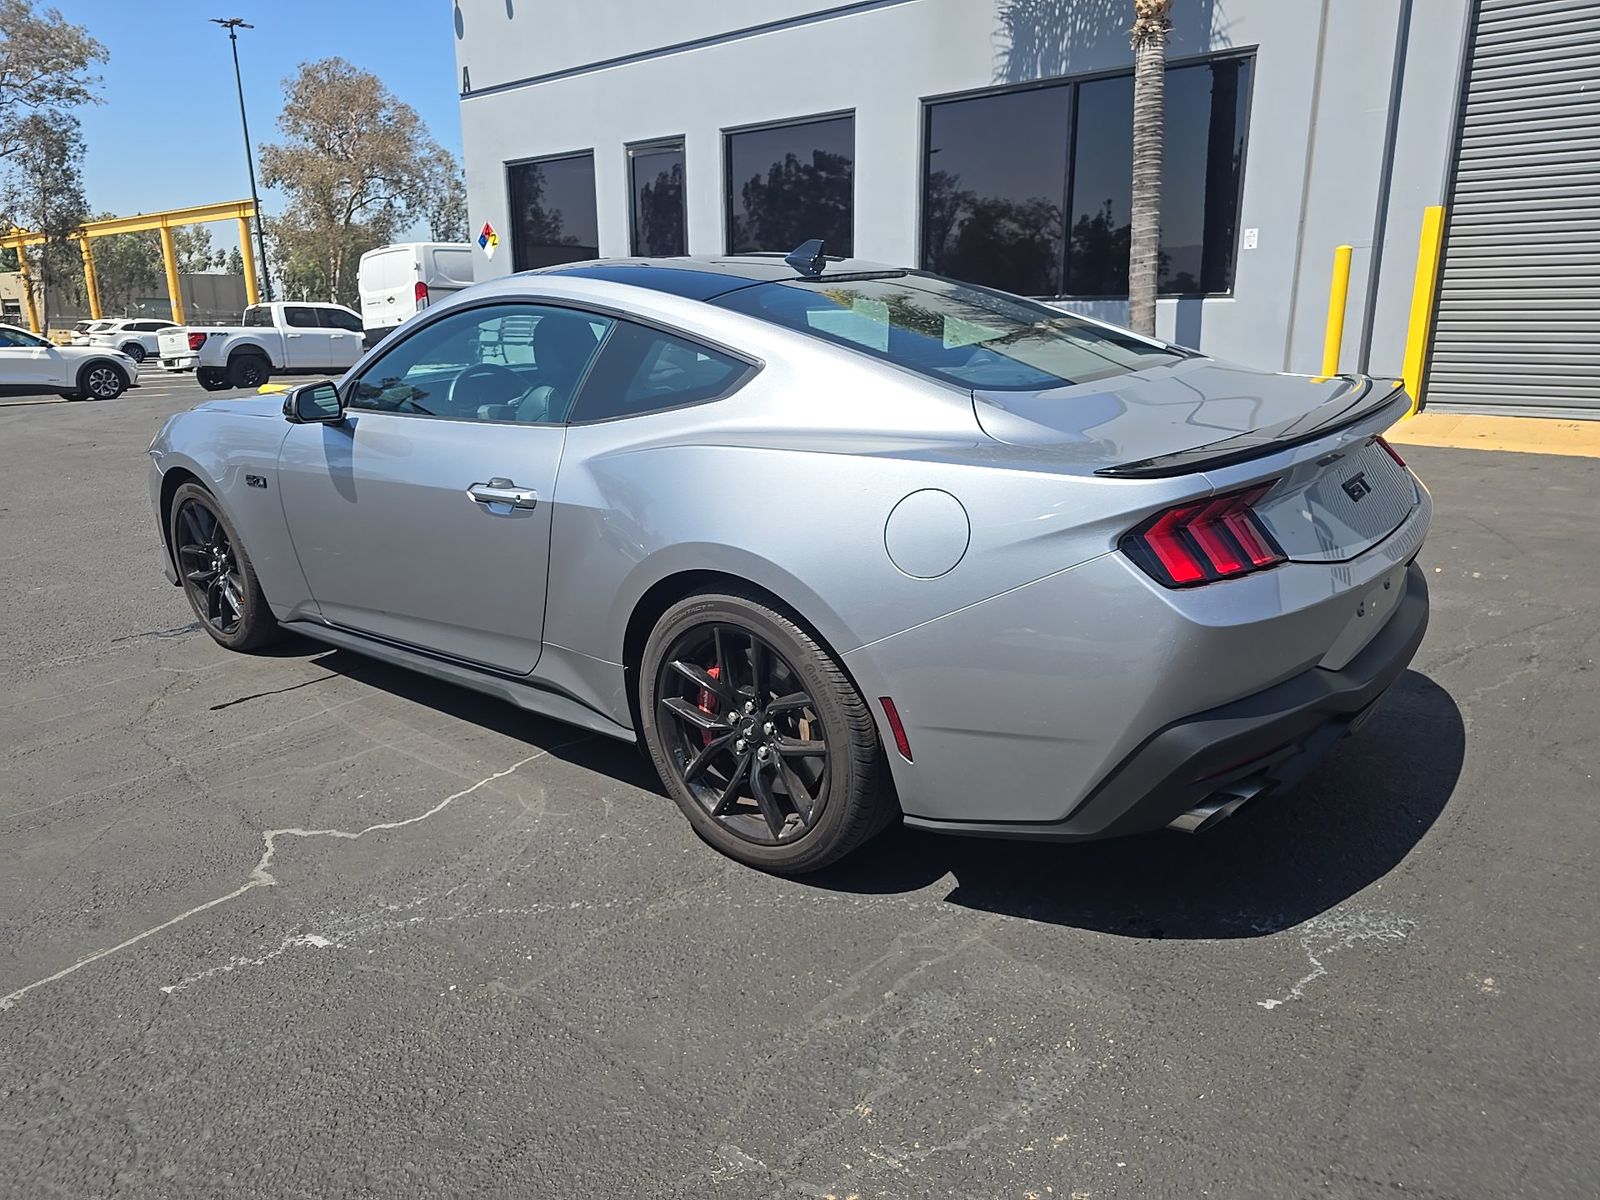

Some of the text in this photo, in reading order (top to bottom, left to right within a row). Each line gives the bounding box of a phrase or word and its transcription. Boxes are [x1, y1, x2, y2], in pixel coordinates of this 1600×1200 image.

[463, 66, 471, 93] A
[491, 233, 498, 246] 2
[1341, 470, 1372, 503] GT
